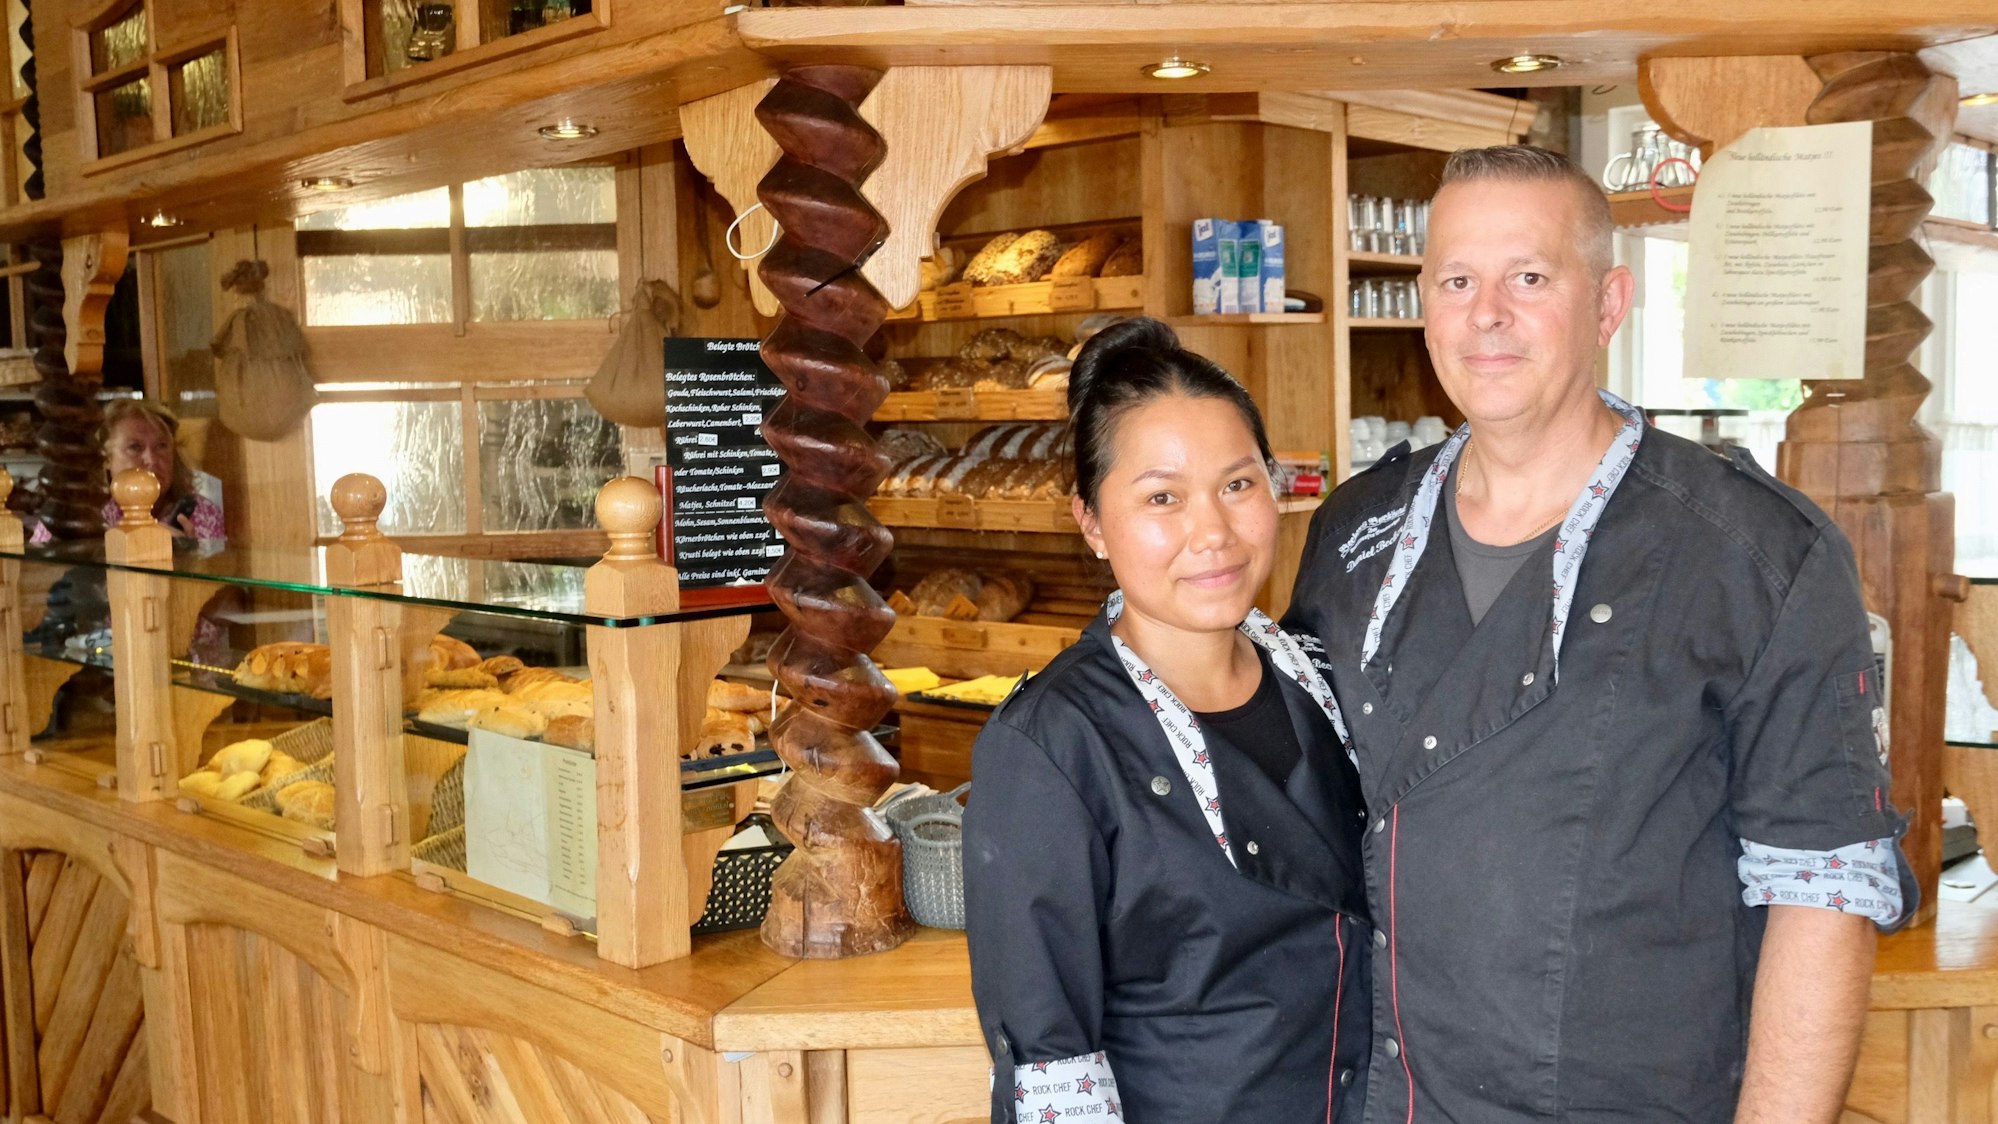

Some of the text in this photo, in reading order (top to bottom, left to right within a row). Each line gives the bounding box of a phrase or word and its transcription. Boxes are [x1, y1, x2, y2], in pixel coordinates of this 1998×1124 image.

[707, 340, 735, 353] Belegte
[665, 371, 755, 384] Belegtes Rosenbrötchen:
[731, 402, 762, 412] Schinken,
[674, 435, 698, 445] Rührei
[683, 451, 706, 460] Rührei
[707, 450, 719, 459] mit
[674, 465, 744, 477] oder Tomate/Schinken
[679, 498, 736, 511] Matjes, Schnitzel
[1564, 499, 1592, 537] ROCK CHEF
[675, 532, 725, 544] Körnerbrötchen
[726, 531, 738, 541] wie
[739, 530, 754, 540] oben
[679, 549, 701, 560] Krusti
[701, 548, 721, 560] belegt
[722, 548, 735, 557] wie
[734, 547, 750, 556] oben
[1346, 545, 1376, 573] Daniel
[1560, 543, 1584, 580] ROCK CHEF
[691, 571, 710, 581] Preise
[711, 569, 726, 578] sind
[1156, 684, 1187, 714] ROCK CHEF
[1161, 717, 1193, 749] ROCK CHEF
[1823, 872, 1845, 881] ROCK
[1779, 891, 1820, 902] ROCK CHEF
[1855, 897, 1875, 909] ROCK
[1032, 1081, 1072, 1095] ROCK CHEF
[1098, 1078, 1108, 1087] ROCK
[1064, 1103, 1103, 1117] ROCK CHEF
[1018, 1111, 1034, 1123] CHEF
